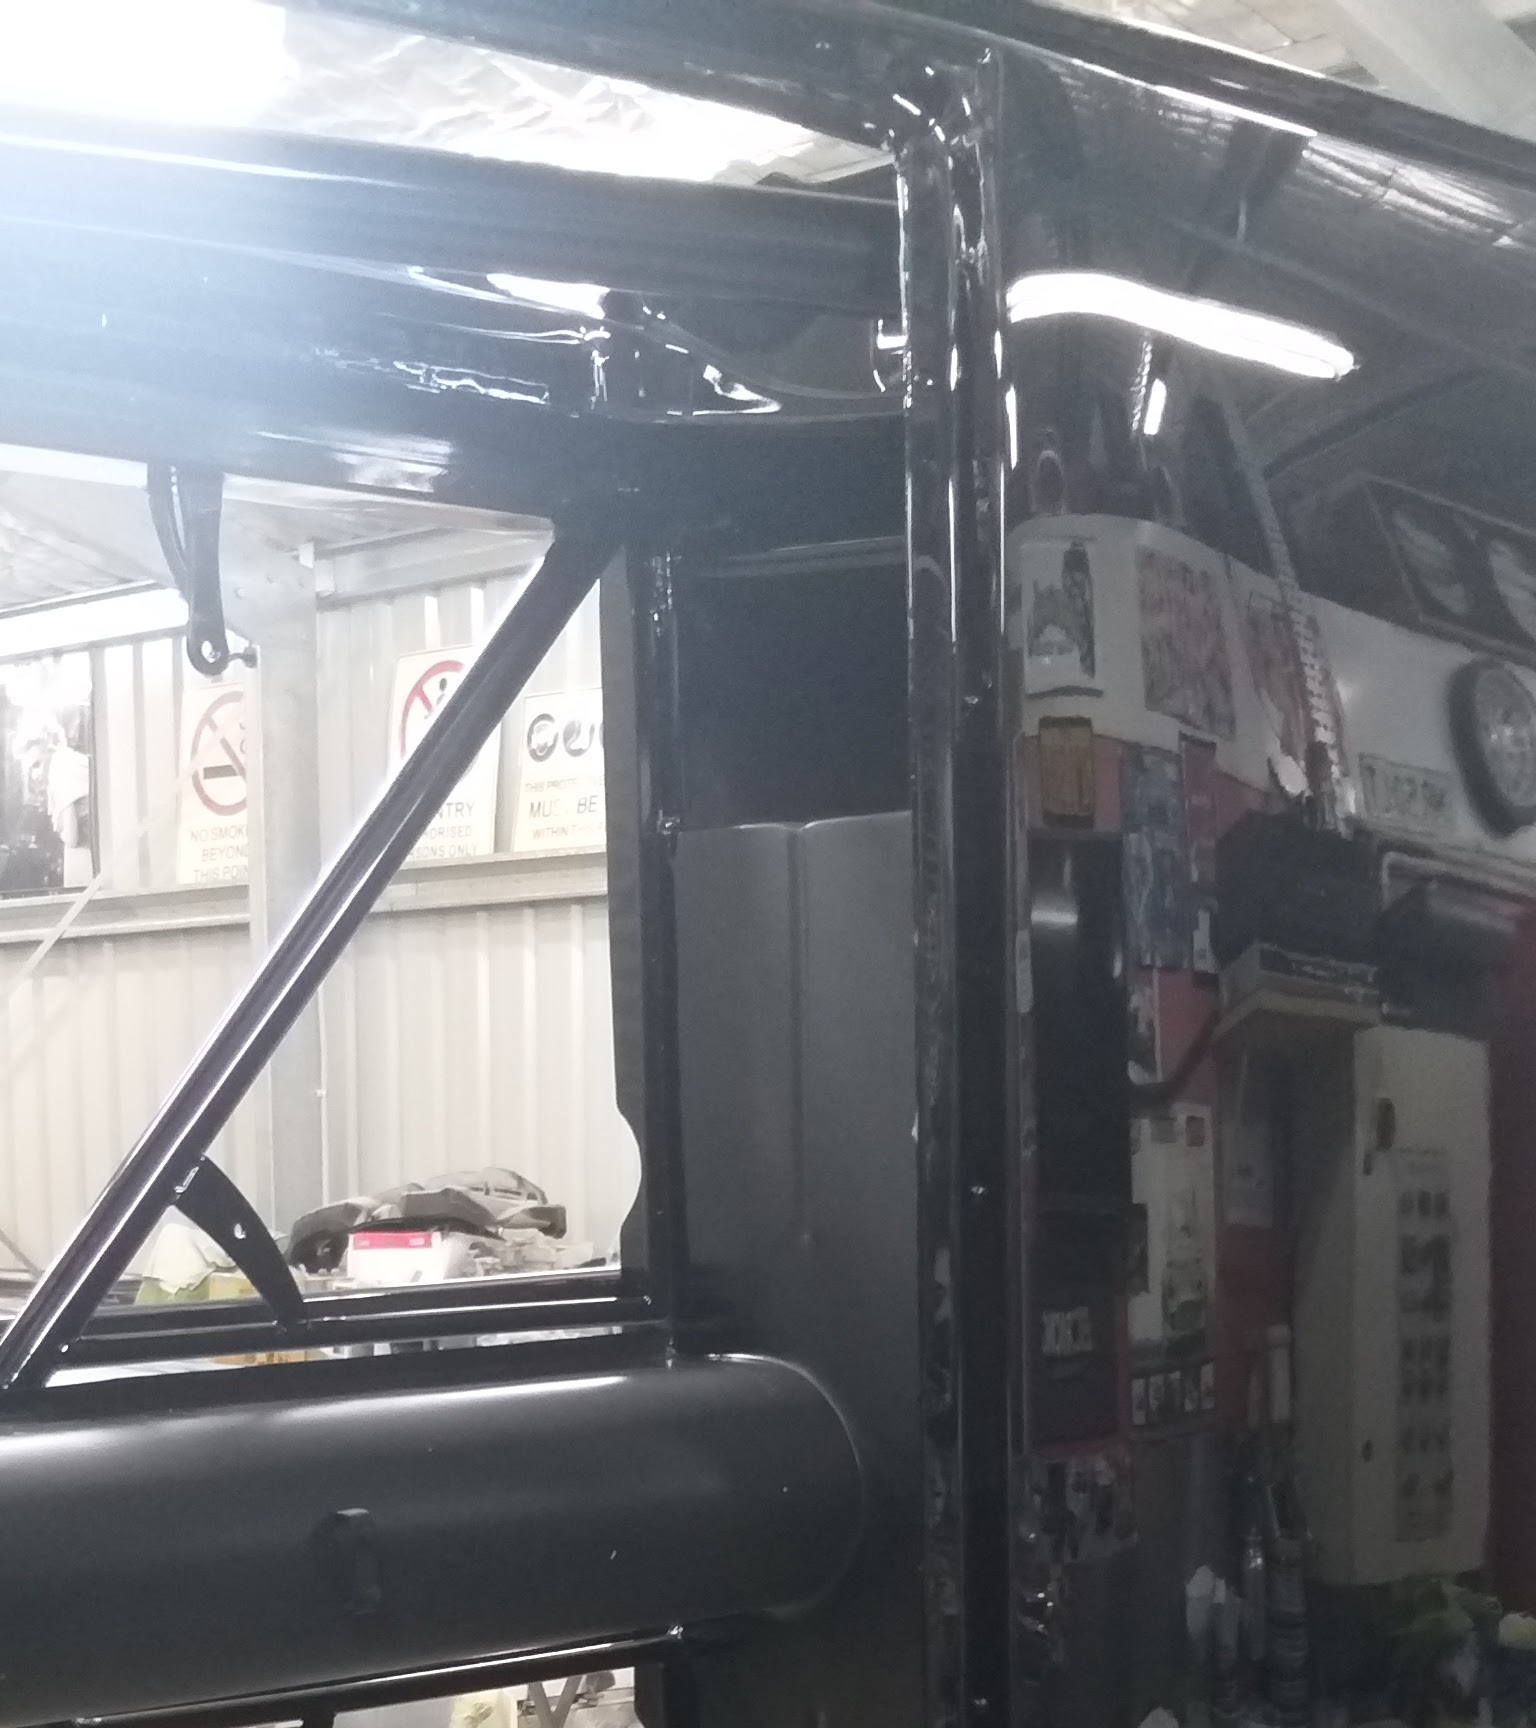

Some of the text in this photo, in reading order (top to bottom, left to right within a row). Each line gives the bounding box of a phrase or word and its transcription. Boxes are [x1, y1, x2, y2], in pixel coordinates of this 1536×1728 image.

[437, 801, 476, 819] NTRY
[576, 795, 599, 814] BE
[191, 829, 209, 842] NO
[532, 826, 569, 841] WITHIN
